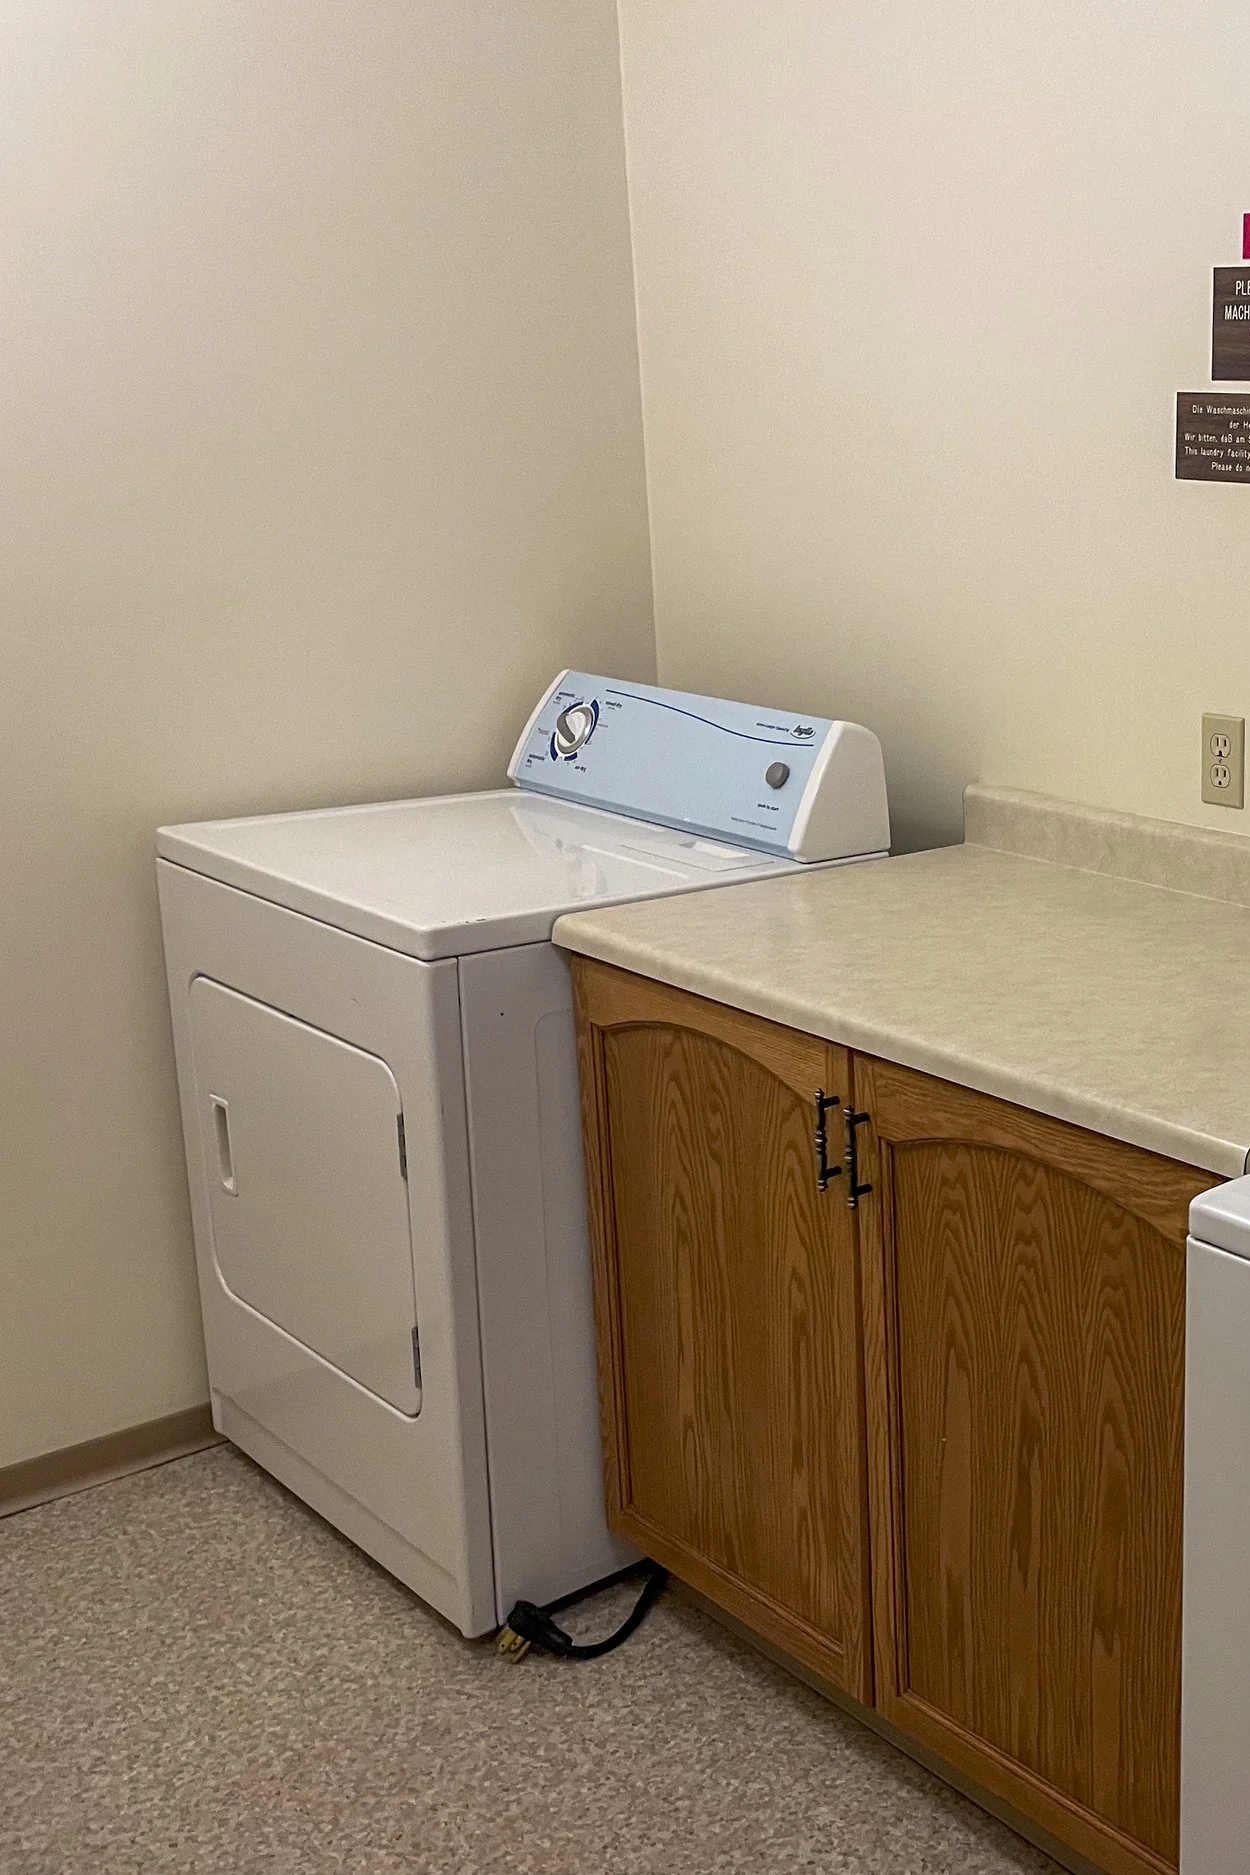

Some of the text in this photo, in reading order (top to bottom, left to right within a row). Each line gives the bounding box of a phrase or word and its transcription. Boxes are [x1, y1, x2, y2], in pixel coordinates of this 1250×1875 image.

[1192, 404, 1203, 414] Die
[1229, 420, 1240, 429] der
[1184, 433, 1196, 441] Wir
[1235, 436, 1245, 444] am
[1185, 446, 1198, 455] This
[1200, 447, 1224, 458] laundry
[1211, 461, 1233, 472] Please
[1235, 463, 1243, 472] do
